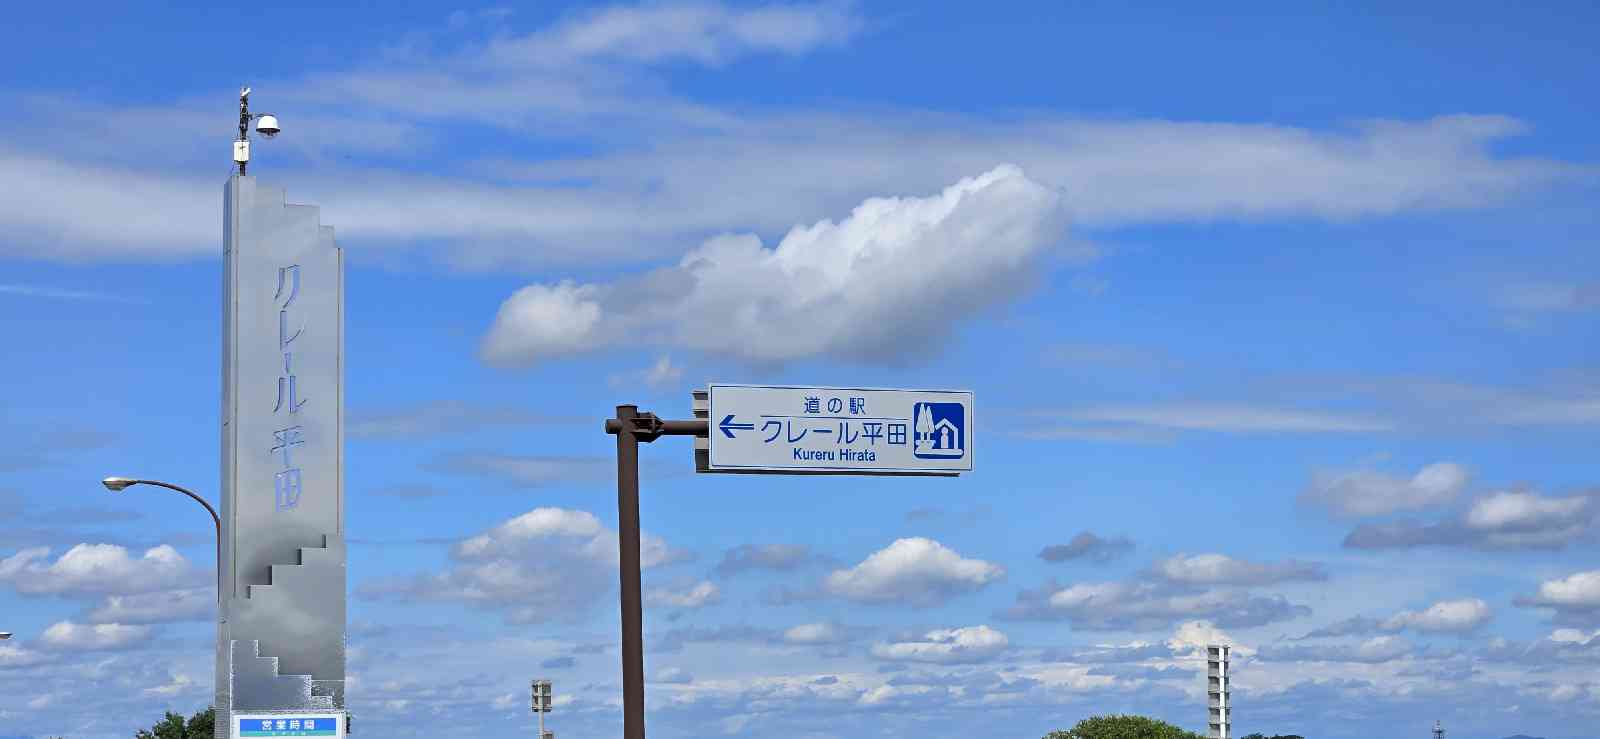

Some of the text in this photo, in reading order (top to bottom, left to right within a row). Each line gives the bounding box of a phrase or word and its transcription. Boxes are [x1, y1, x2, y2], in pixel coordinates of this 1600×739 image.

[271, 264, 307, 512] クレール平田
[803, 396, 866, 415] 道の駅
[760, 419, 907, 446] クレール平田
[793, 448, 876, 462] Kureru Hirata
[261, 719, 315, 731] 営業時間
